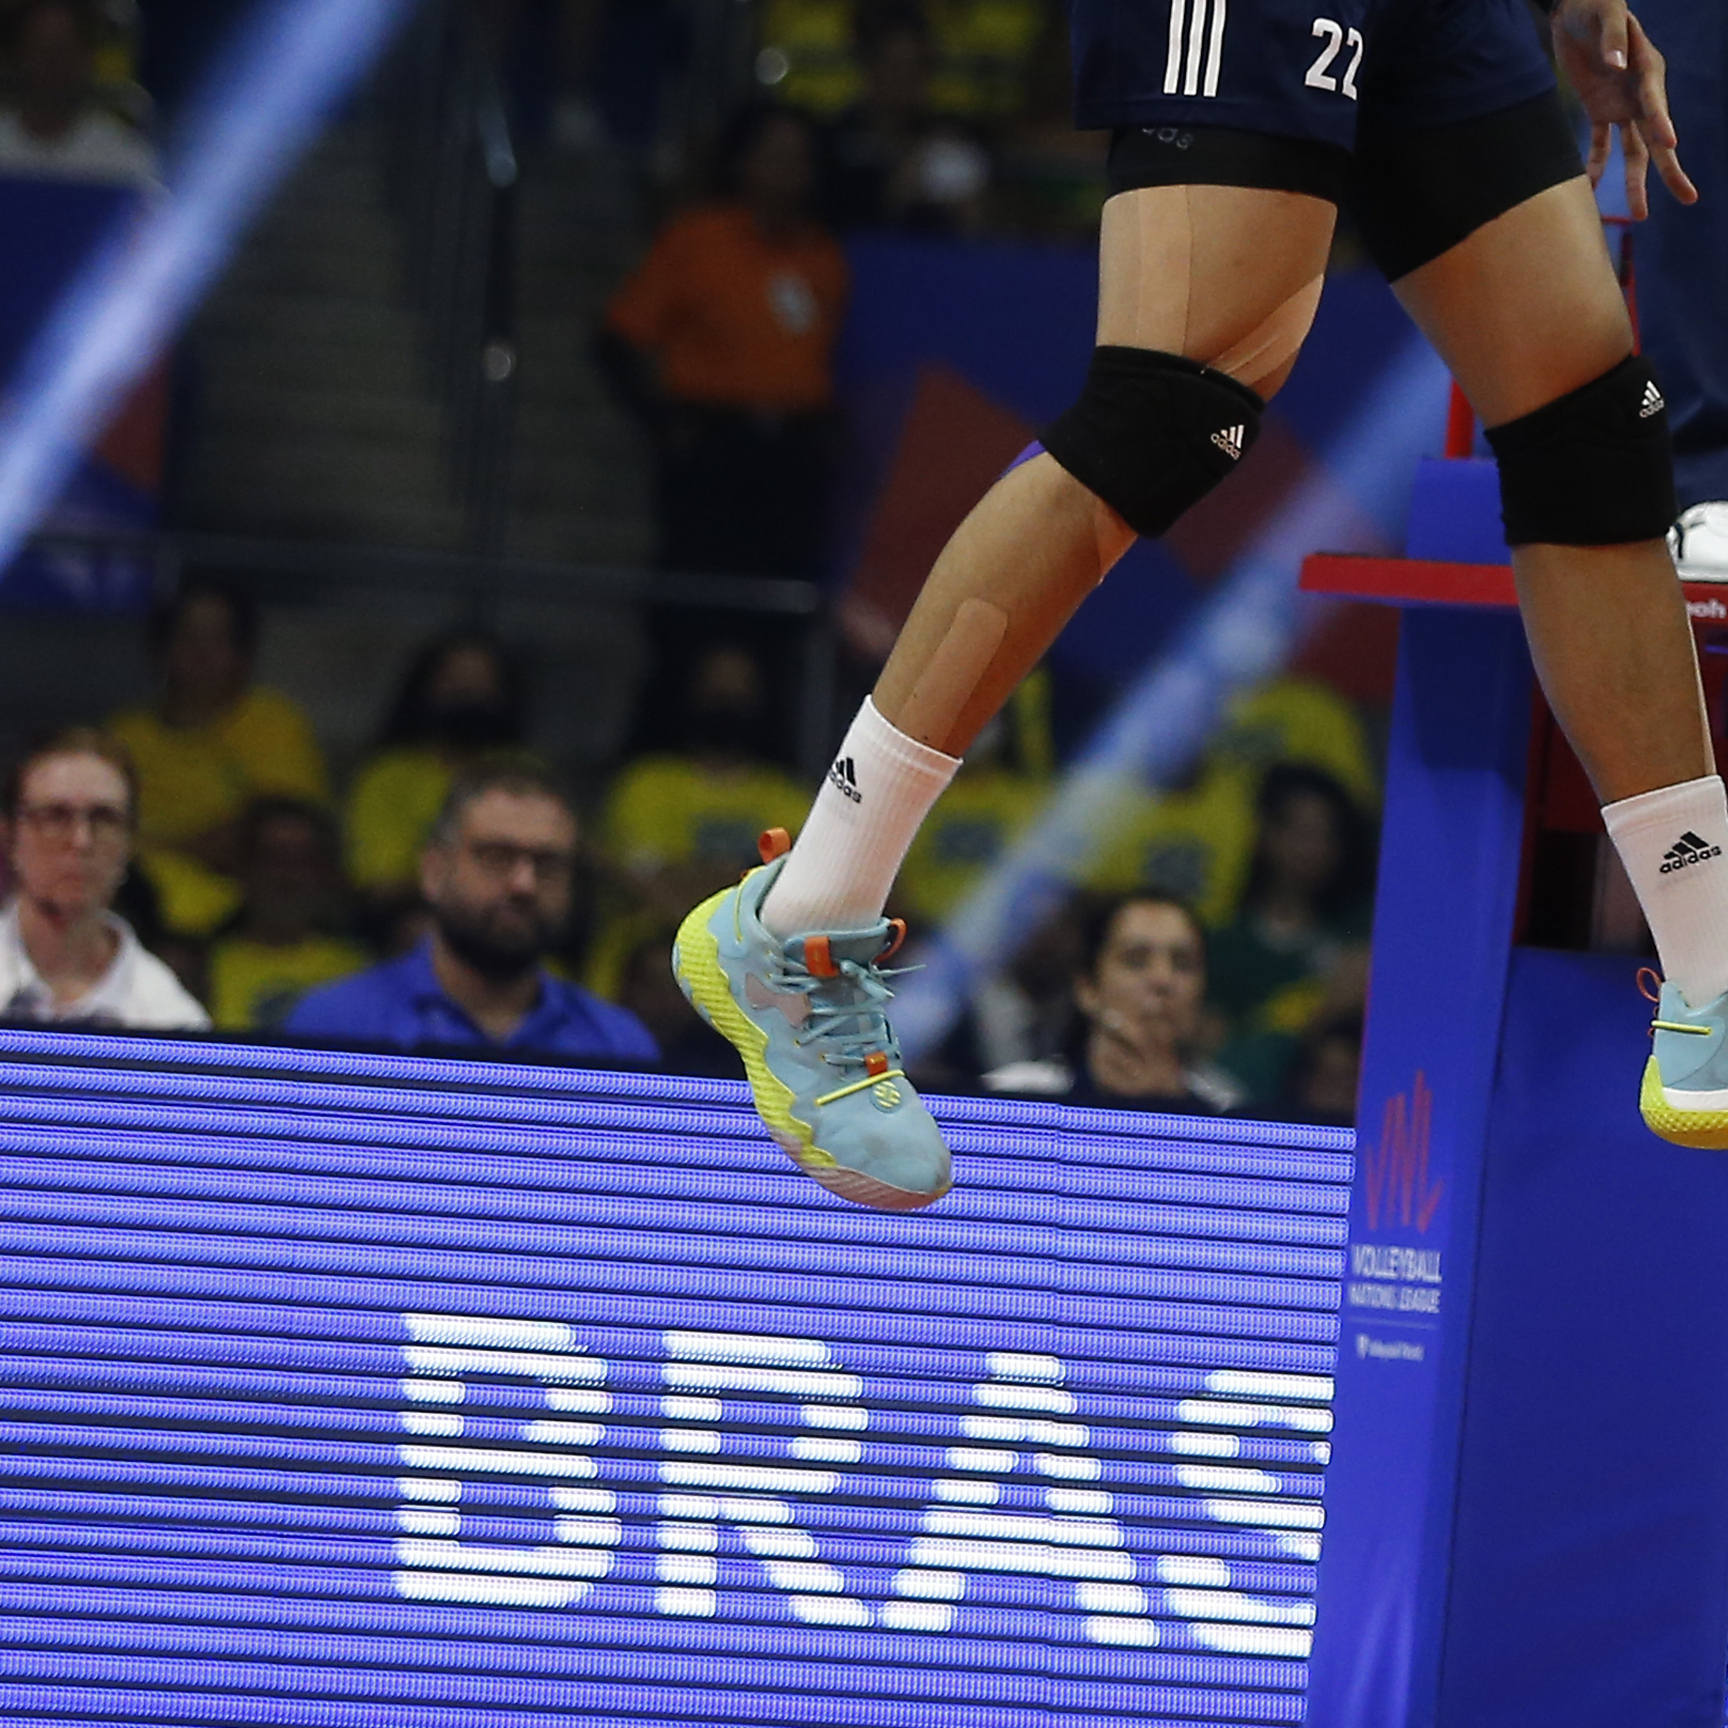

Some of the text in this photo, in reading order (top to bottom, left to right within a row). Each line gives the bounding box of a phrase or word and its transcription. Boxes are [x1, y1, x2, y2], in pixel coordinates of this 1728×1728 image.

[1304, 17, 1365, 101] 22
[1659, 845, 1723, 873] adidas
[1351, 1243, 1442, 1284] VOLLEYBALL
[392, 1309, 1335, 1657] BRAS
